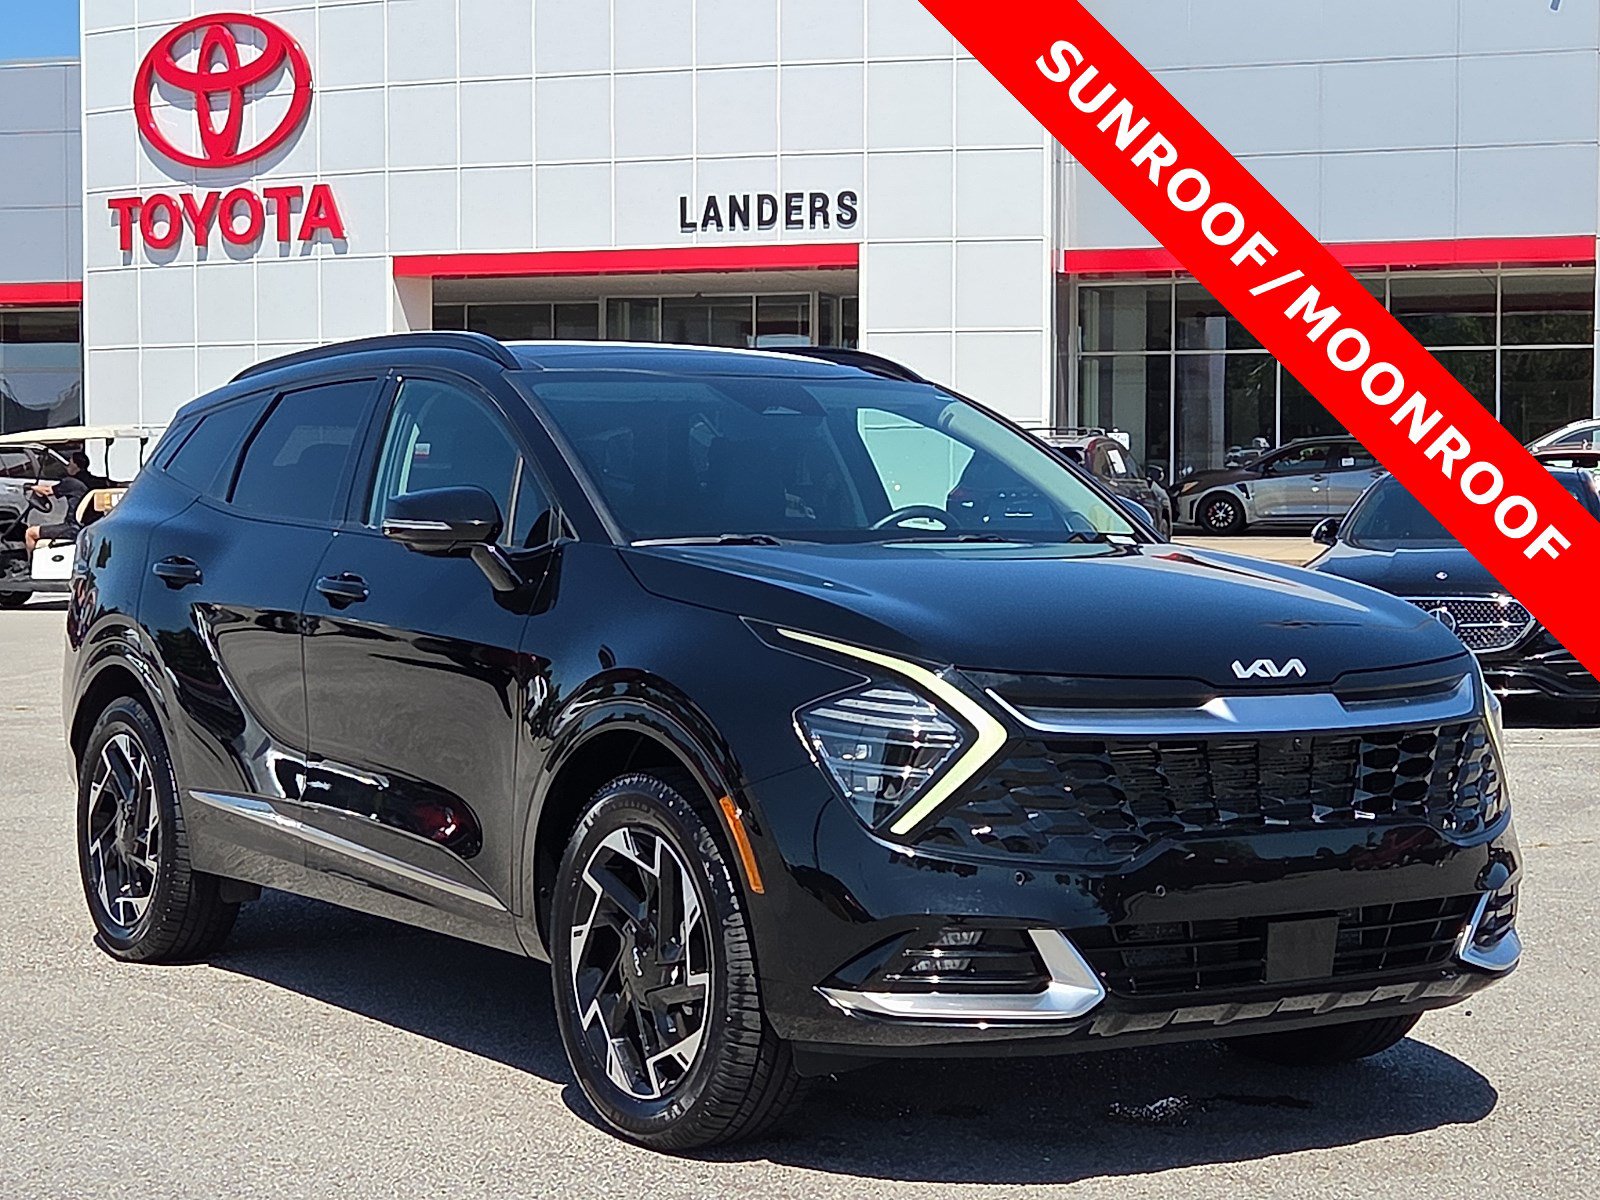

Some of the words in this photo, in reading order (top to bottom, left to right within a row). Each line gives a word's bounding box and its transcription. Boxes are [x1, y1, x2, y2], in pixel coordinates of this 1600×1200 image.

[108, 184, 346, 251] TOYOTA
[679, 190, 859, 231] LANDERS
[1231, 658, 1307, 678] KIA
